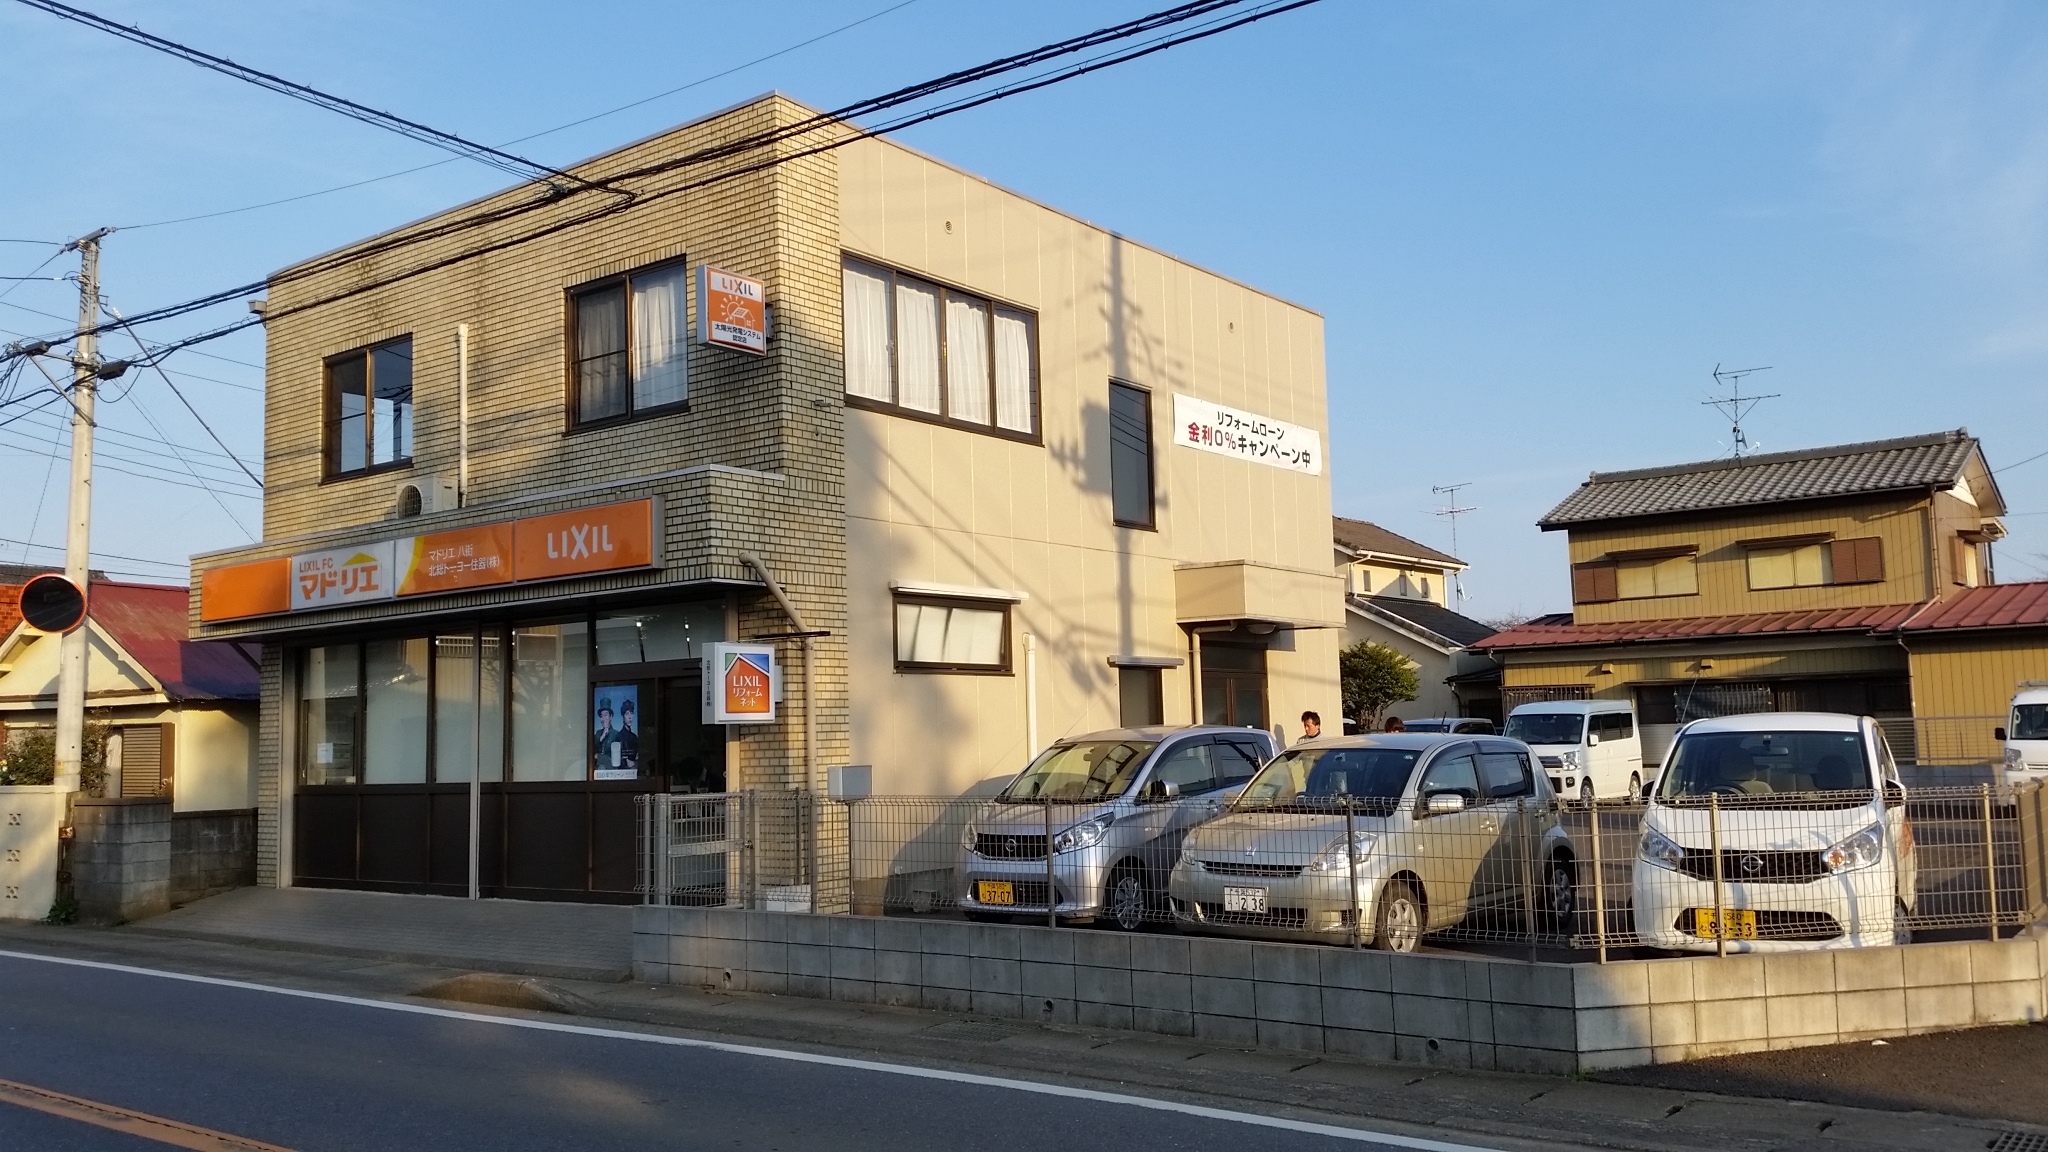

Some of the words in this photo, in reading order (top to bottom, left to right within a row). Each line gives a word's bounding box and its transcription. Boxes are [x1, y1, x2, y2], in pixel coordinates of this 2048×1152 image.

[722, 277, 753, 296] LIXIL
[714, 323, 761, 340] 太陽光発電システム
[1217, 411, 1285, 440] リフォームローン
[547, 523, 613, 560] LIXIL
[428, 547, 455, 561] マドリエ
[457, 543, 473, 557] 八街
[299, 560, 320, 573] LIXIL
[322, 557, 334, 570] FC
[298, 564, 379, 600] マドリエ
[733, 675, 762, 687] LIXIL
[733, 688, 763, 697] リフォーム
[740, 697, 756, 707] ネット
